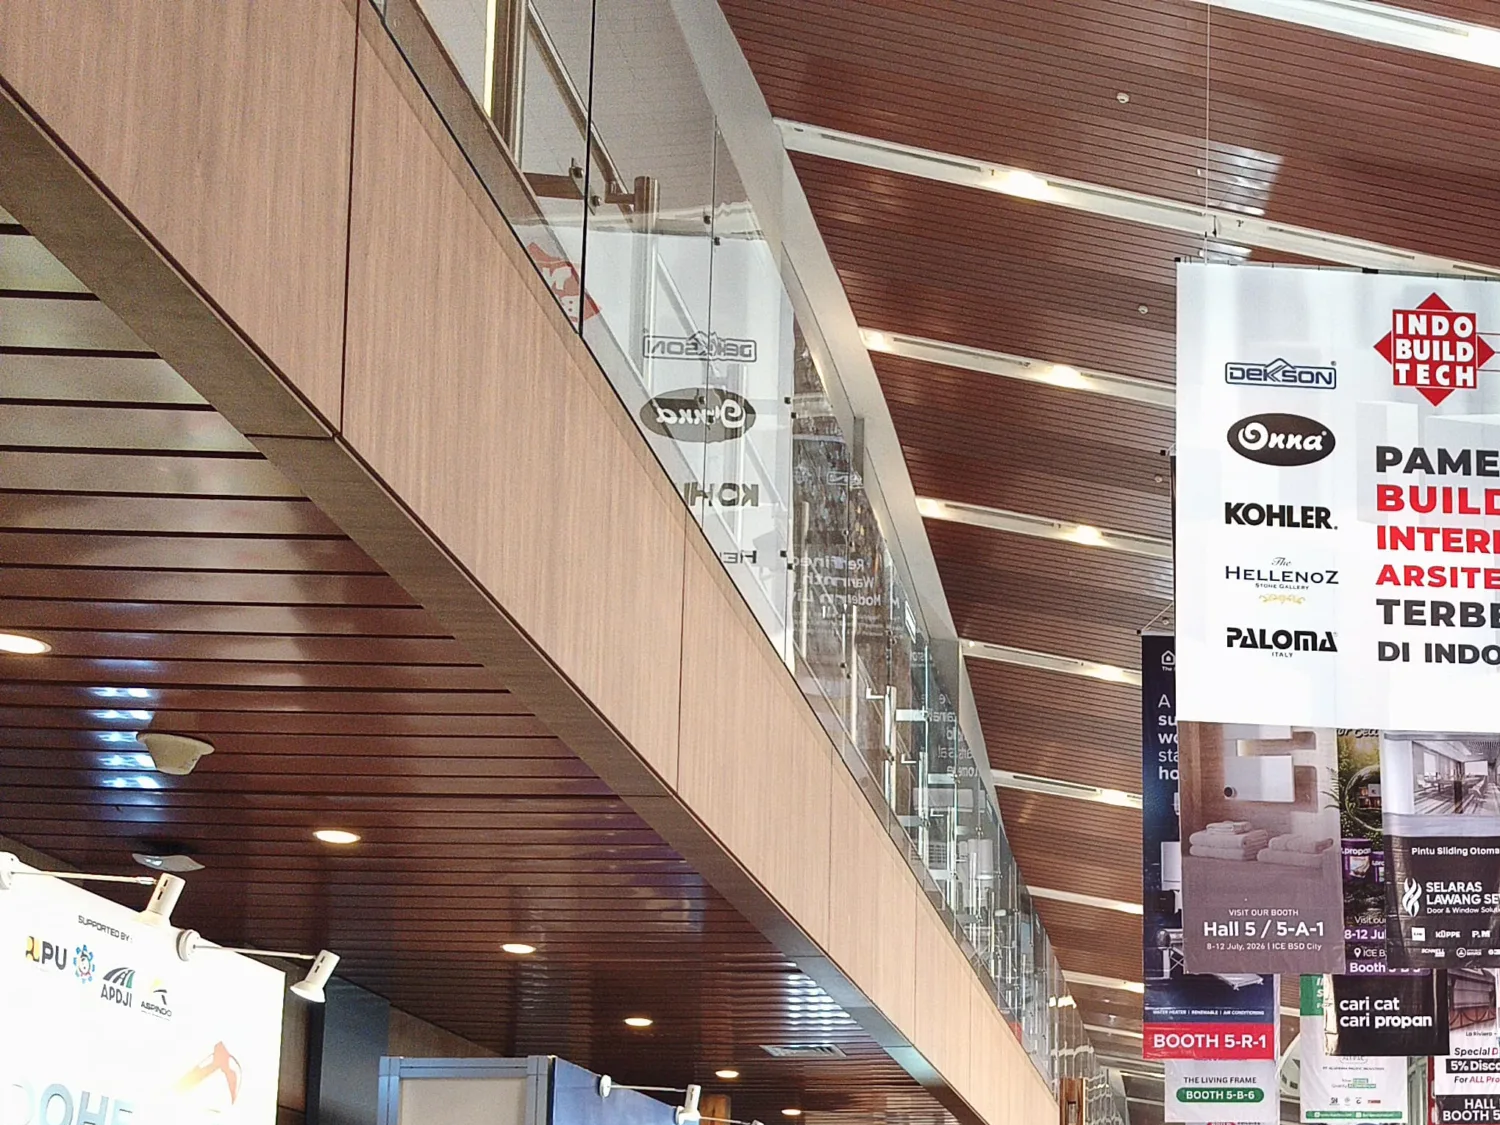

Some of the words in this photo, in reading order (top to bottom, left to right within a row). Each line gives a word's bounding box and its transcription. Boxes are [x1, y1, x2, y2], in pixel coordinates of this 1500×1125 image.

[1396, 314, 1473, 338] INDO
[1396, 339, 1474, 362] BUILD
[1395, 363, 1474, 387] TECH
[1378, 641, 1410, 662] DI
[1412, 847, 1435, 855] Pintu
[1437, 847, 1468, 856] Sliding
[1426, 882, 1482, 893] SELARAS
[1427, 894, 1481, 905] LAWANG
[1228, 909, 1248, 917] VISIT
[1251, 909, 1269, 917] OUR
[1271, 909, 1299, 917] BOOTH
[78, 915, 119, 939] SUPPORTED
[1203, 920, 1239, 937] Hall
[1244, 921, 1256, 937] 5
[1276, 920, 1324, 937] 5-A-1
[1344, 930, 1368, 939] 8-12
[1272, 943, 1285, 951] ICE
[1286, 943, 1305, 951] BSD
[42, 941, 67, 971] PU
[1350, 962, 1386, 973] Booth
[101, 984, 132, 1008] APDJI
[1340, 997, 1369, 1011] cari
[1374, 998, 1400, 1011] cat
[1340, 1013, 1370, 1027] cari
[1375, 1015, 1432, 1028] propan
[1153, 1034, 1219, 1048] BOOTH
[1224, 1034, 1267, 1048] 5-R-1
[1454, 1047, 1490, 1057] Special
[1451, 1061, 1469, 1070] 5%
[1186, 1090, 1224, 1100] BOOTH
[1465, 1099, 1496, 1109] HALL
[1443, 1110, 1489, 1121] BOOTH
